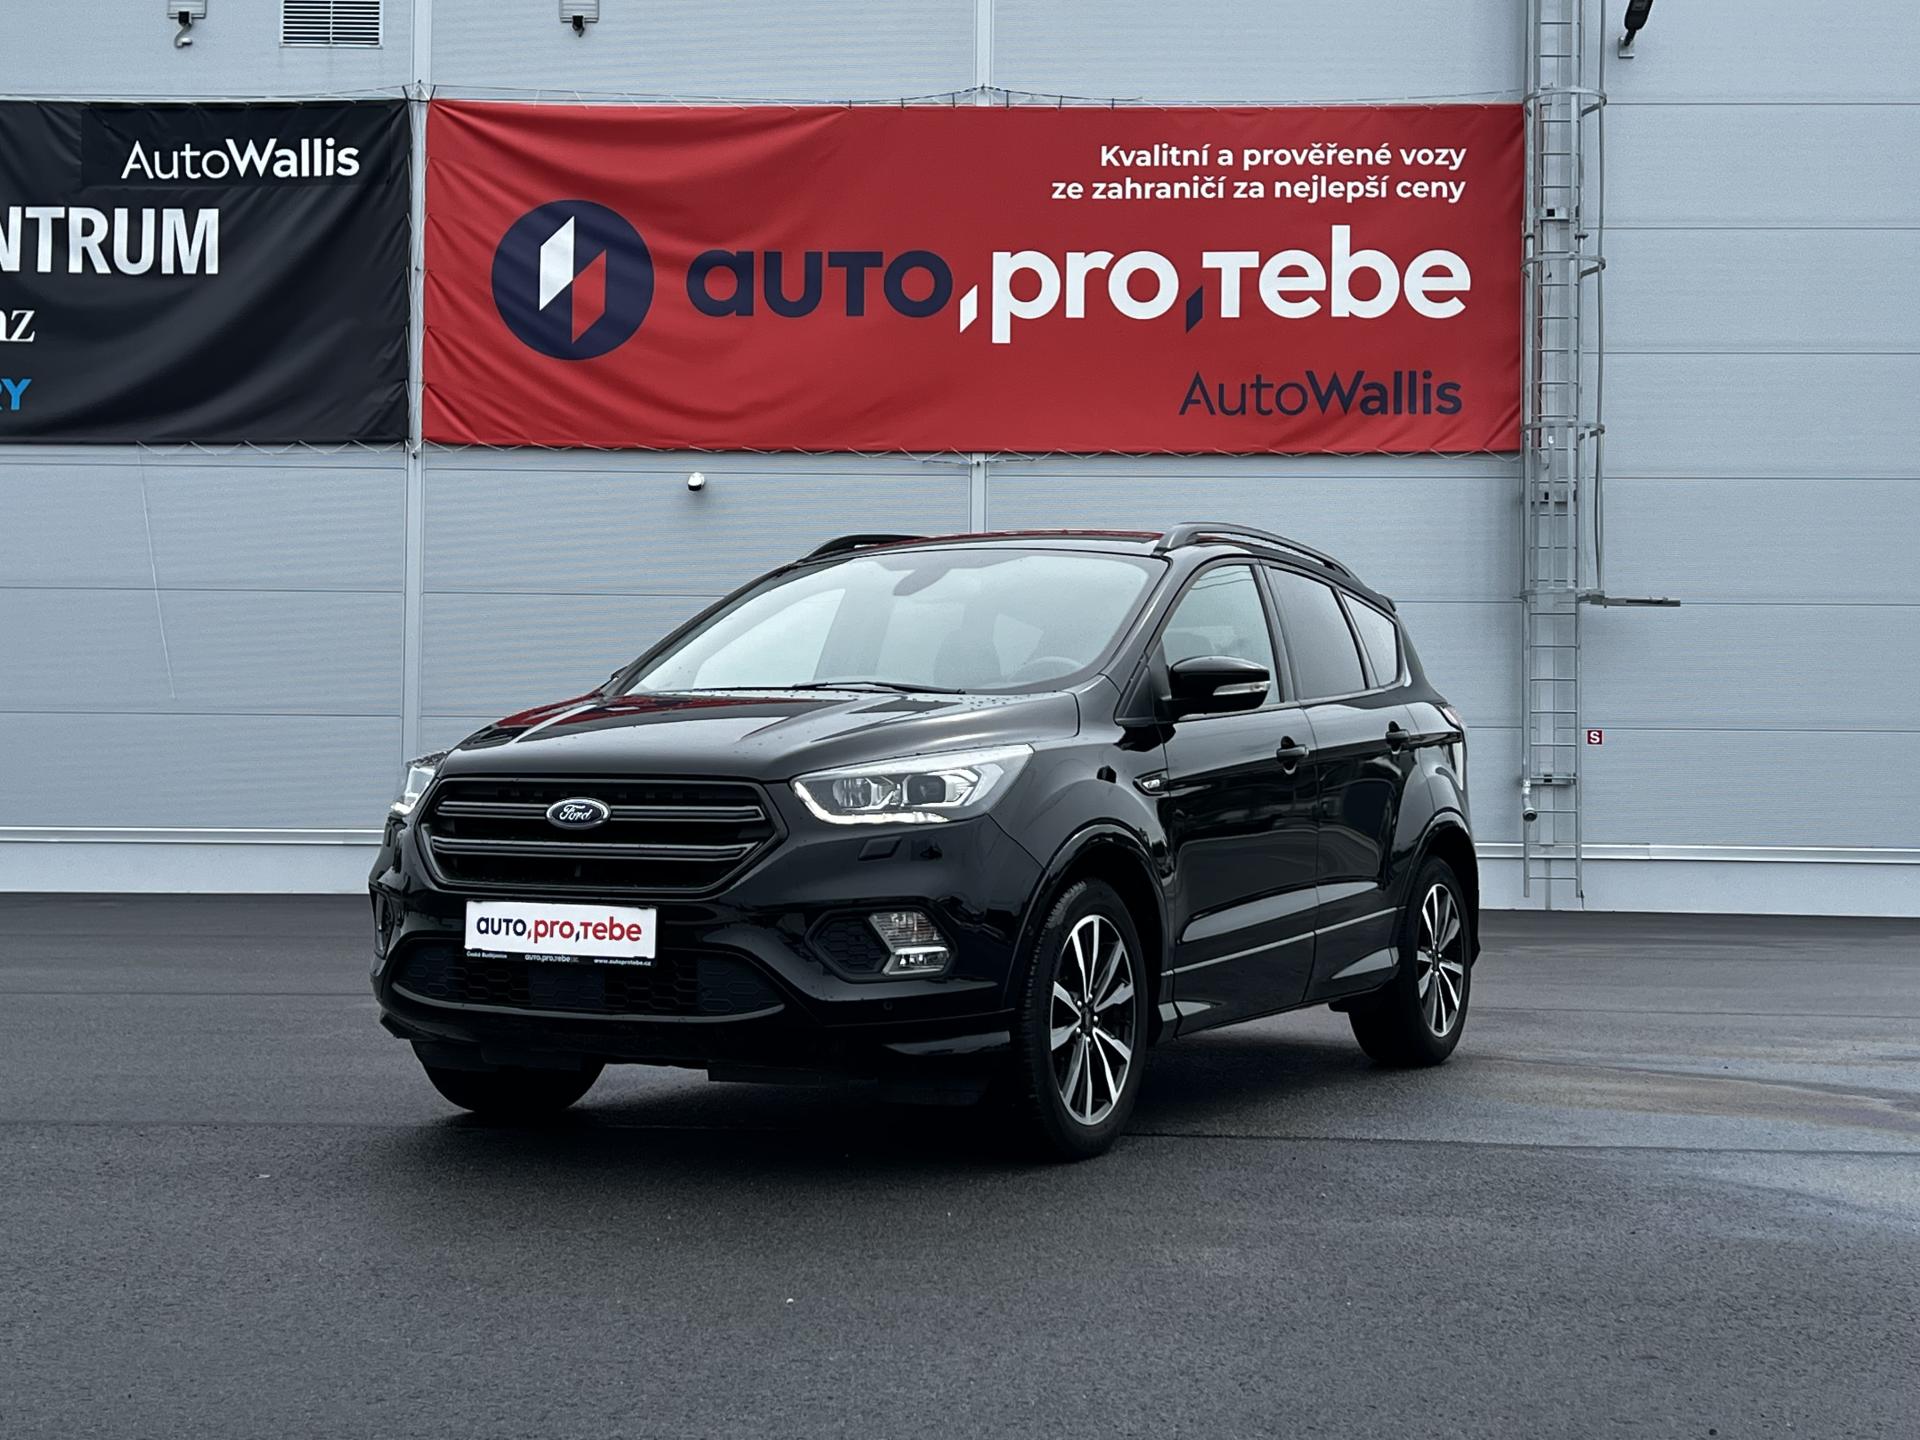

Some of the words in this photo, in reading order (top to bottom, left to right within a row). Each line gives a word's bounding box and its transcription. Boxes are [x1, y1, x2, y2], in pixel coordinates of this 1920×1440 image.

[121, 137, 360, 180] AutoWallis
[1100, 143, 1209, 167] Kvalitní
[1217, 149, 1234, 166] a
[1243, 143, 1392, 170] prověřené
[1399, 149, 1467, 170] vozy
[1051, 182, 1084, 200] ze
[1092, 176, 1226, 200] zahraničí
[1233, 182, 1265, 199] za
[1274, 175, 1387, 204] nejlepší
[1395, 181, 1467, 204] ceny
[1179, 370, 1462, 417] AutoWallis
[1590, 731, 1601, 743] S
[559, 804, 593, 821] Ford
